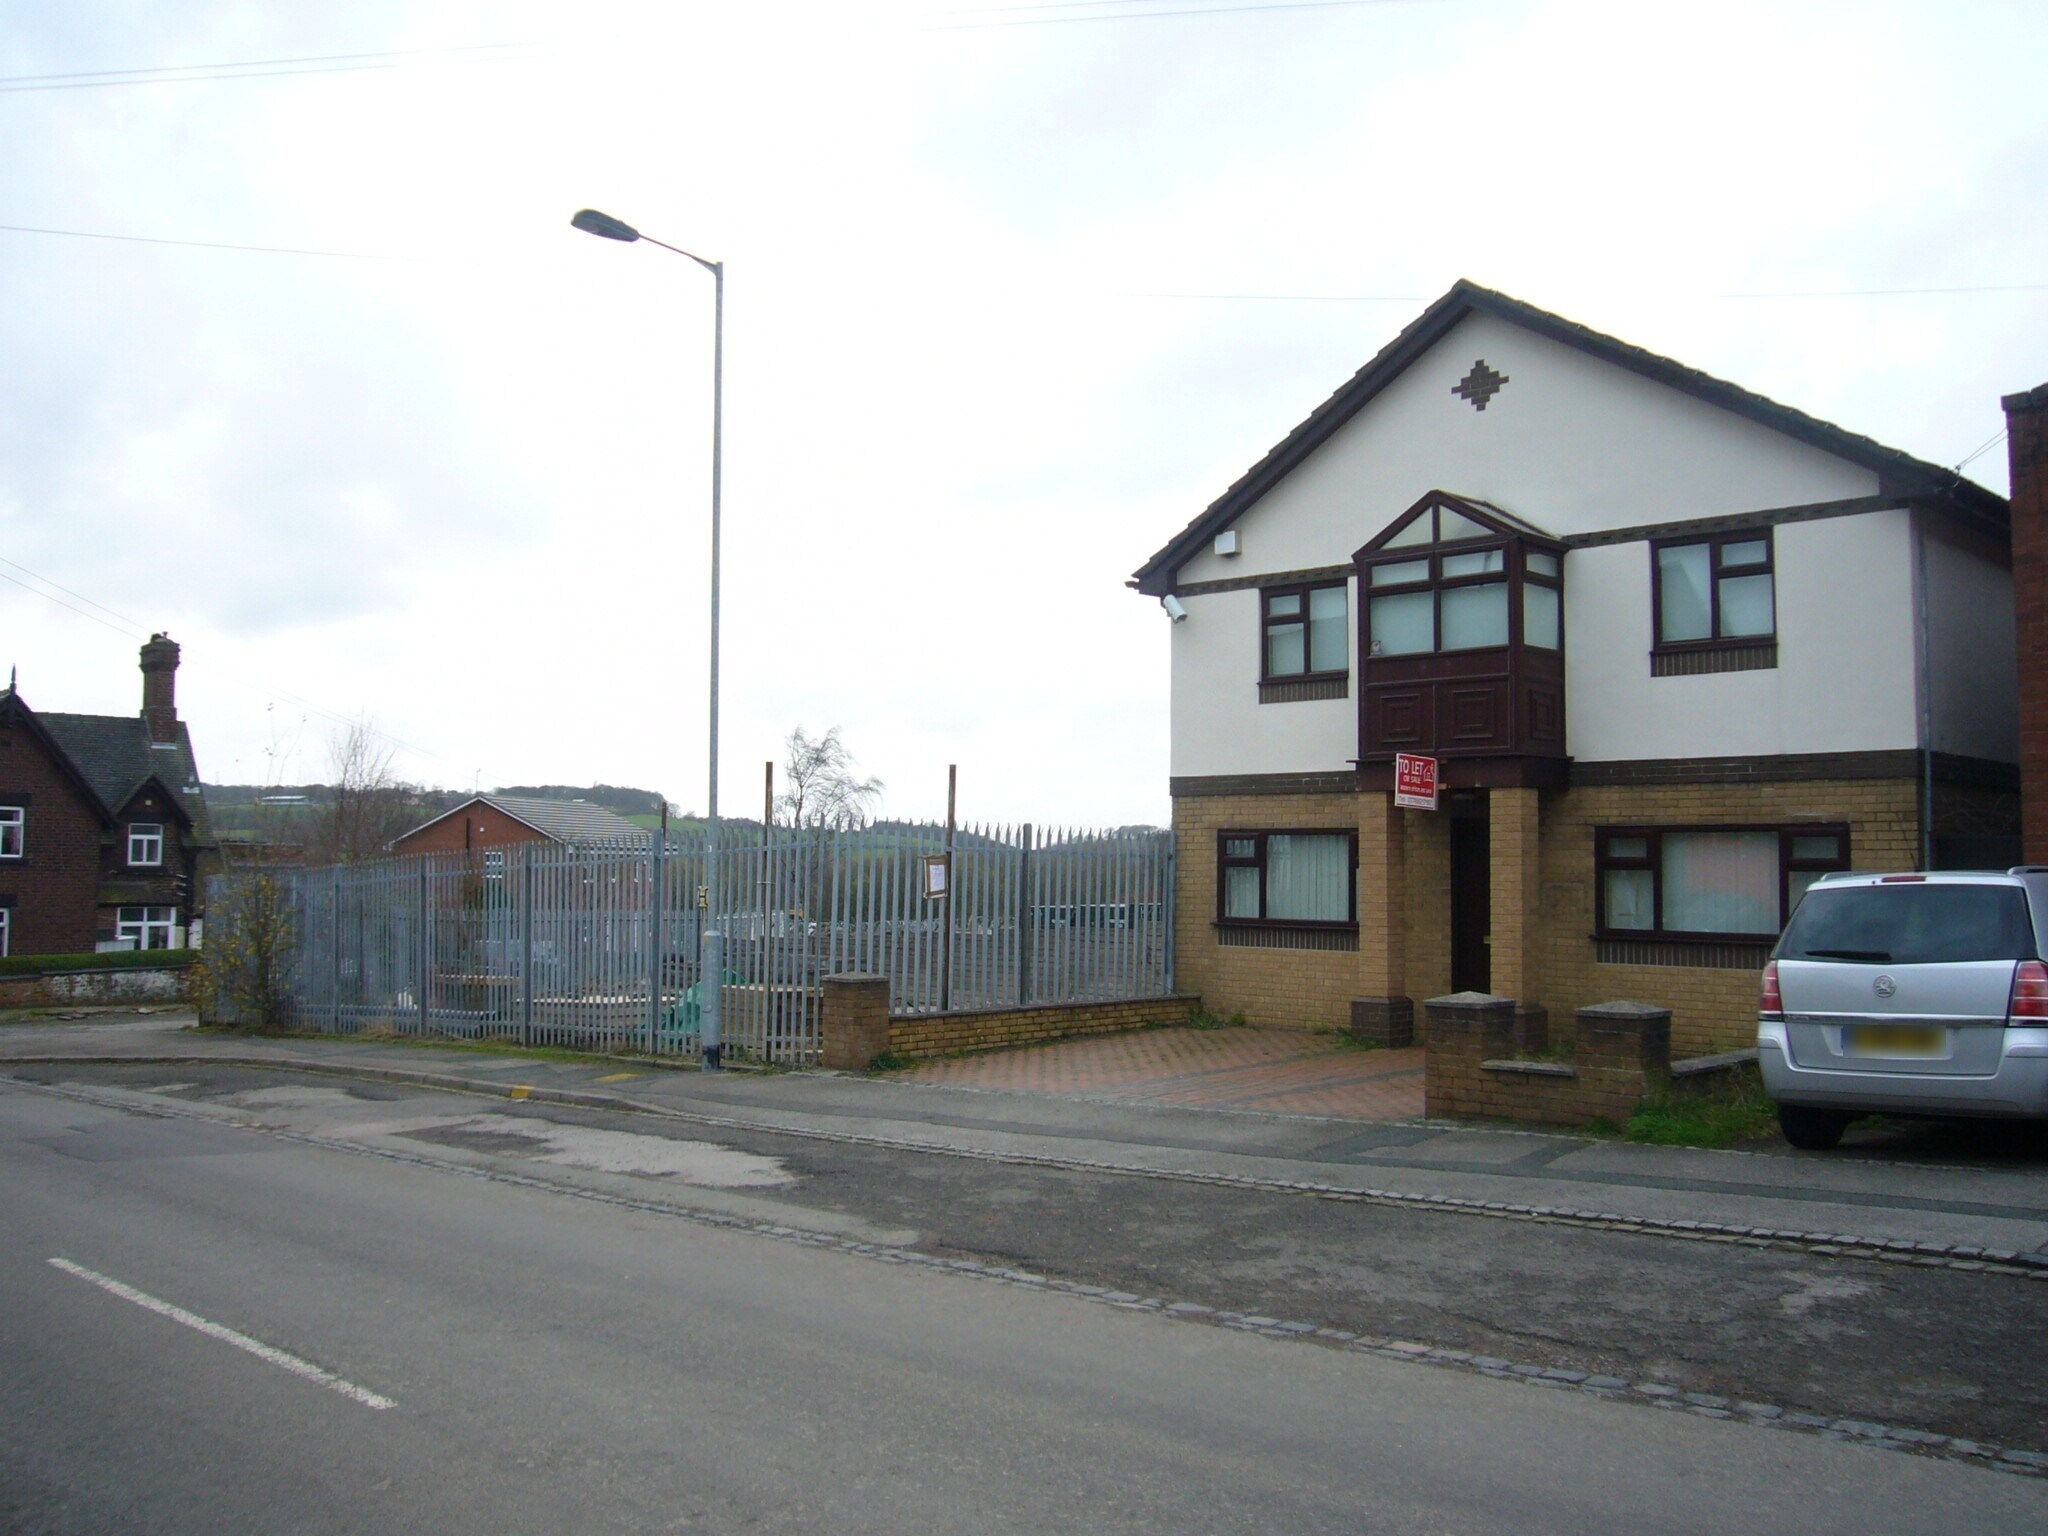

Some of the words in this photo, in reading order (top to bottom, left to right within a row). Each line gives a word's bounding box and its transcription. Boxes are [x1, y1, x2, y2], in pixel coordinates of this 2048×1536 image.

[1399, 759, 1409, 773] TO
[1411, 761, 1424, 776] LET
[1410, 776, 1422, 784] SALE
